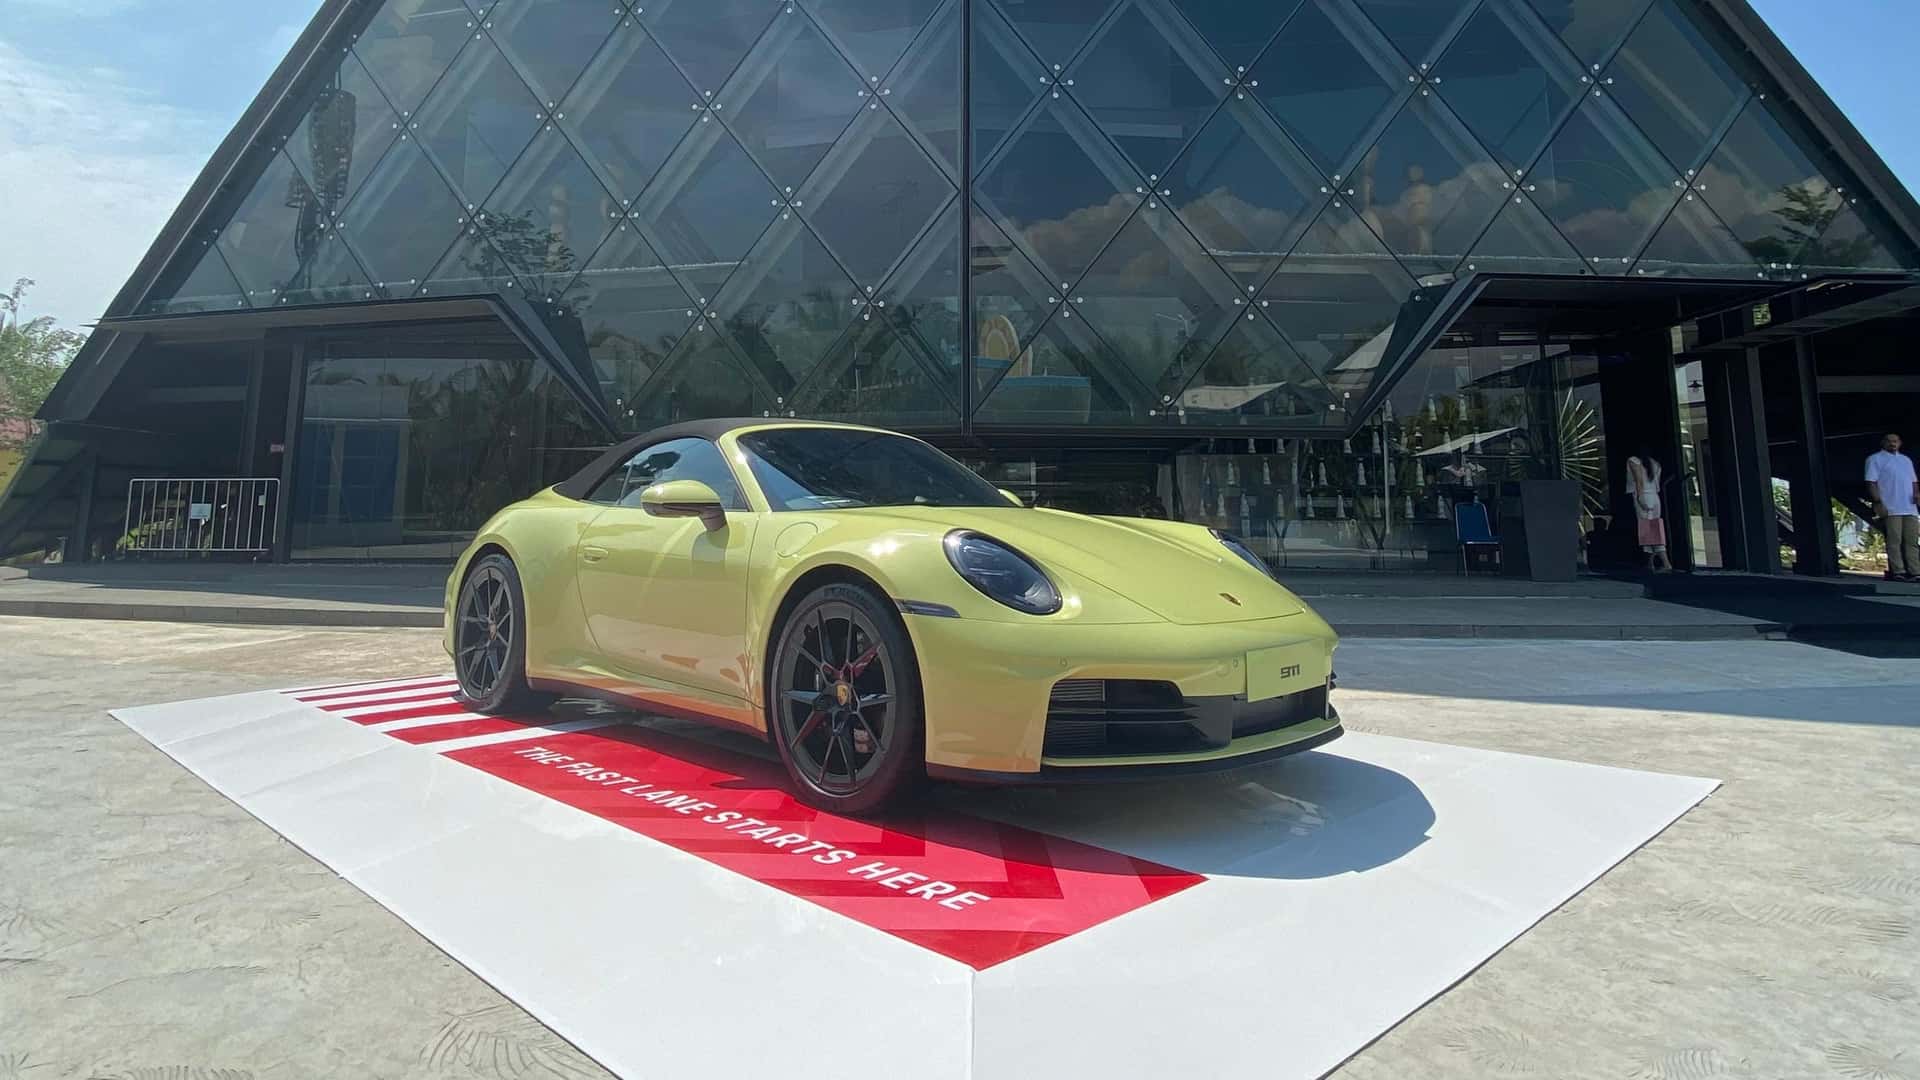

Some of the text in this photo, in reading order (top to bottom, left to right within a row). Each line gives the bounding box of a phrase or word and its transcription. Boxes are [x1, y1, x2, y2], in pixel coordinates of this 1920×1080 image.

[1280, 664, 1300, 679] 911
[513, 746, 991, 910] THE FAST LANE STARTS HERE
